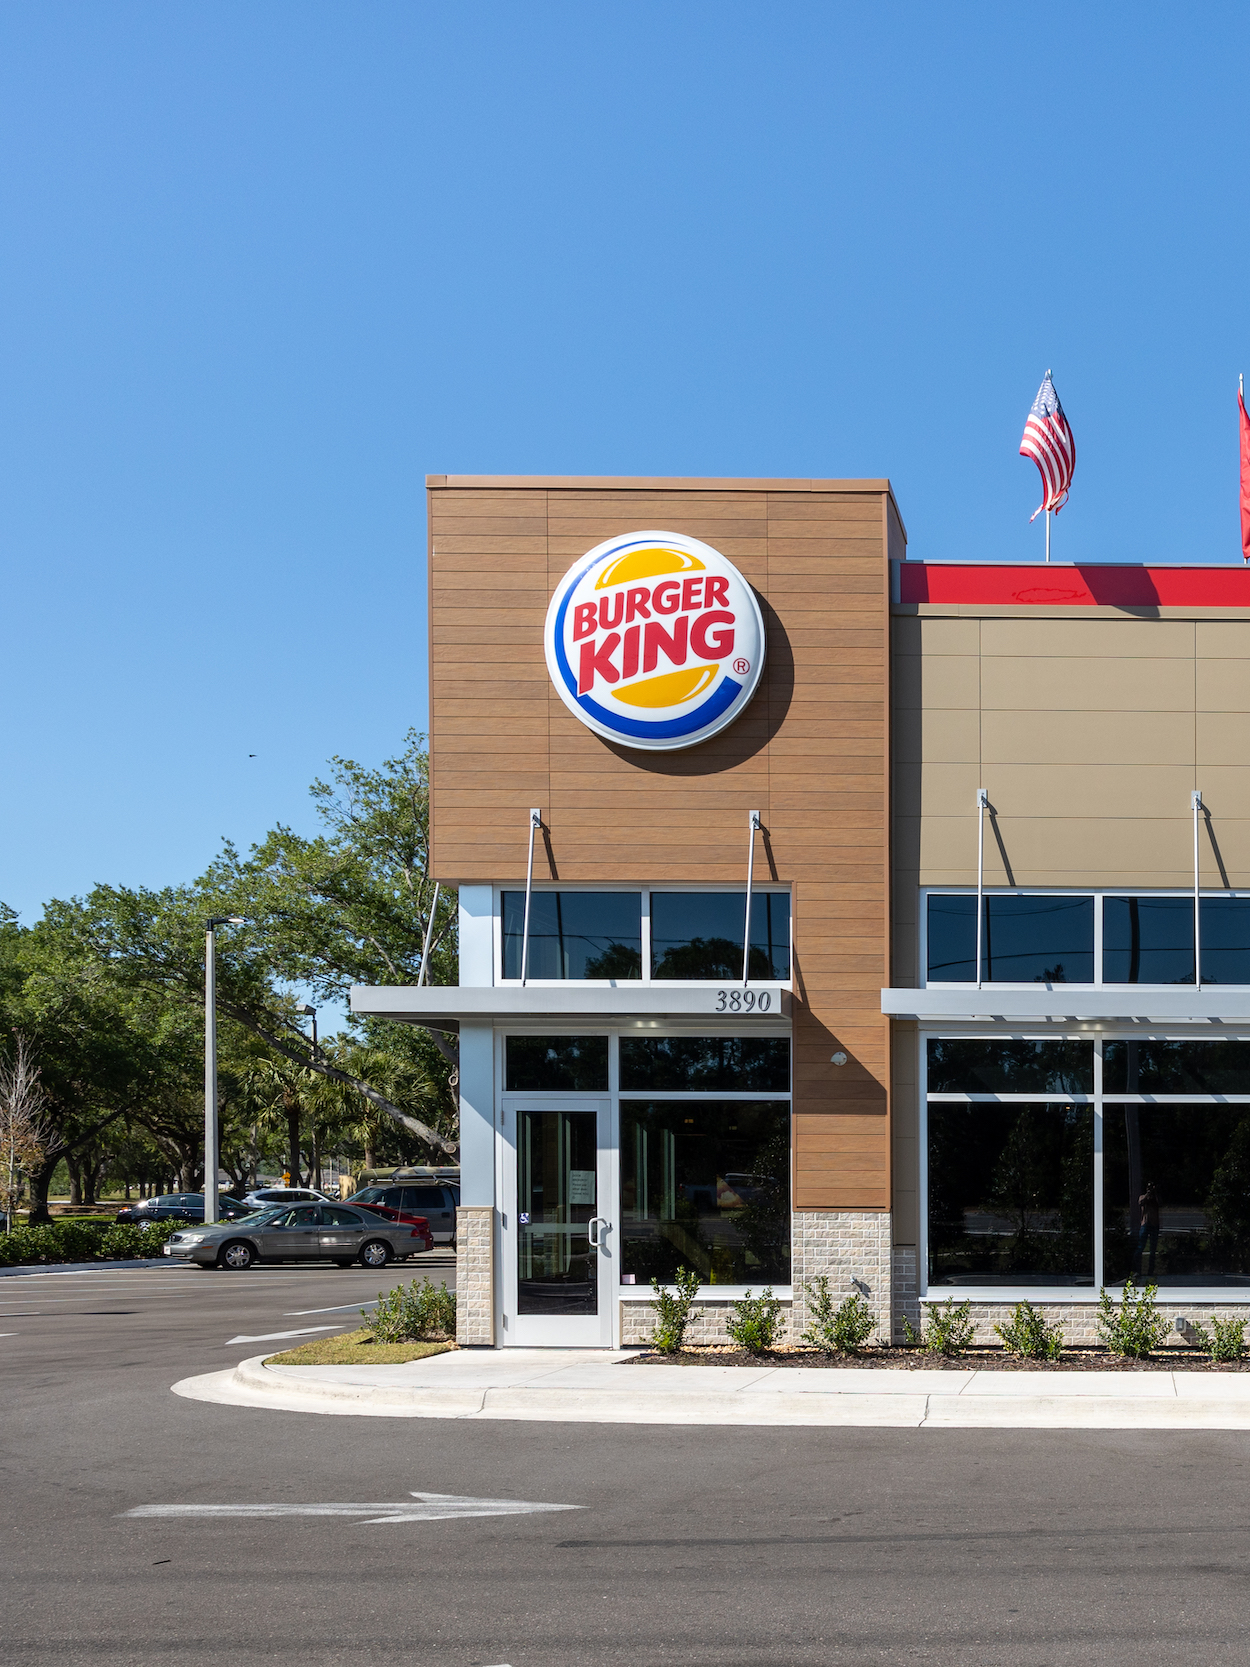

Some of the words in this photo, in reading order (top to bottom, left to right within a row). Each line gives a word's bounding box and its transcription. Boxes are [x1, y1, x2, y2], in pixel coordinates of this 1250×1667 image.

[573, 576, 730, 642] BURGER
[579, 610, 736, 694] KING
[715, 990, 771, 1012] 3890
